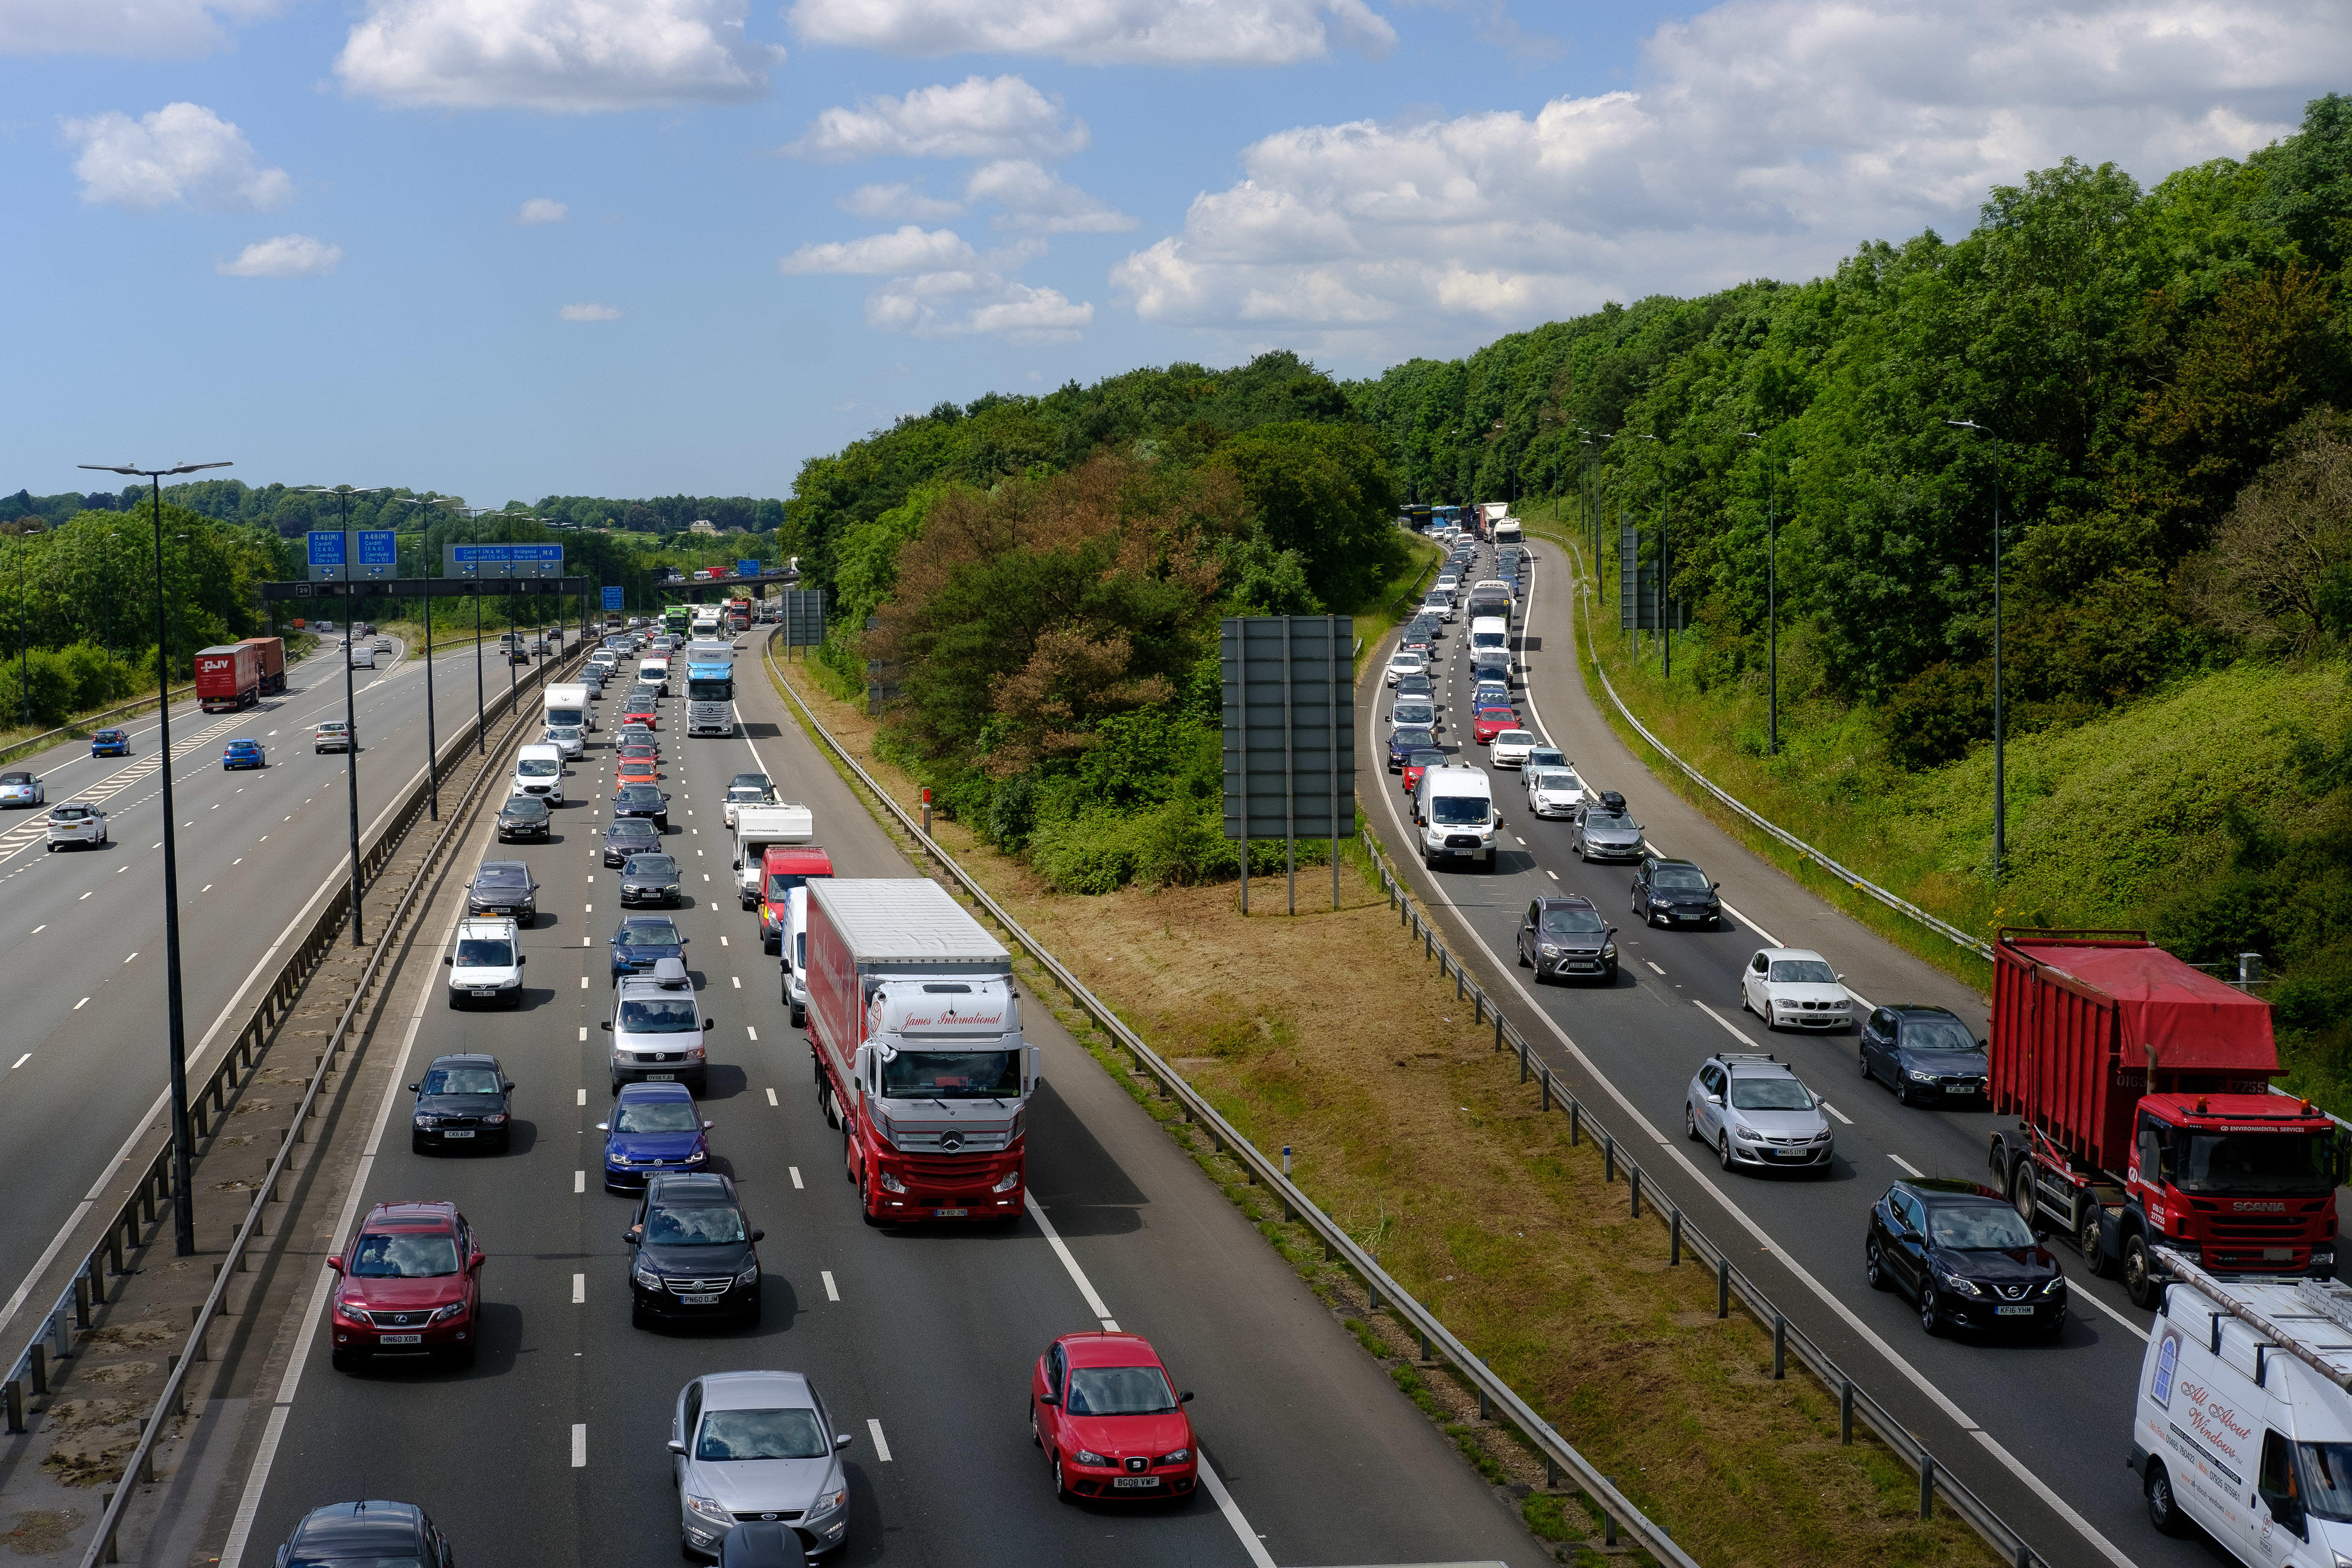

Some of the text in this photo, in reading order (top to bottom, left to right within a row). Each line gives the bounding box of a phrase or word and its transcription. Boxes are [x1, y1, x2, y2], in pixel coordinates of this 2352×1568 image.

[901, 1011, 1002, 1032] James International
[2152, 1203, 2164, 1215] 01633
[2233, 1202, 2286, 1212] SCANIA
[2181, 1382, 2251, 1440] All About
[2189, 1407, 2236, 1458] Windows
[2166, 1434, 2178, 1452] 01495
[2180, 1445, 2195, 1465] 760422
[1118, 1478, 1156, 1487] BG08 VWF
[2210, 1470, 2223, 1488] 07925
[2224, 1482, 2240, 1502] 975961
